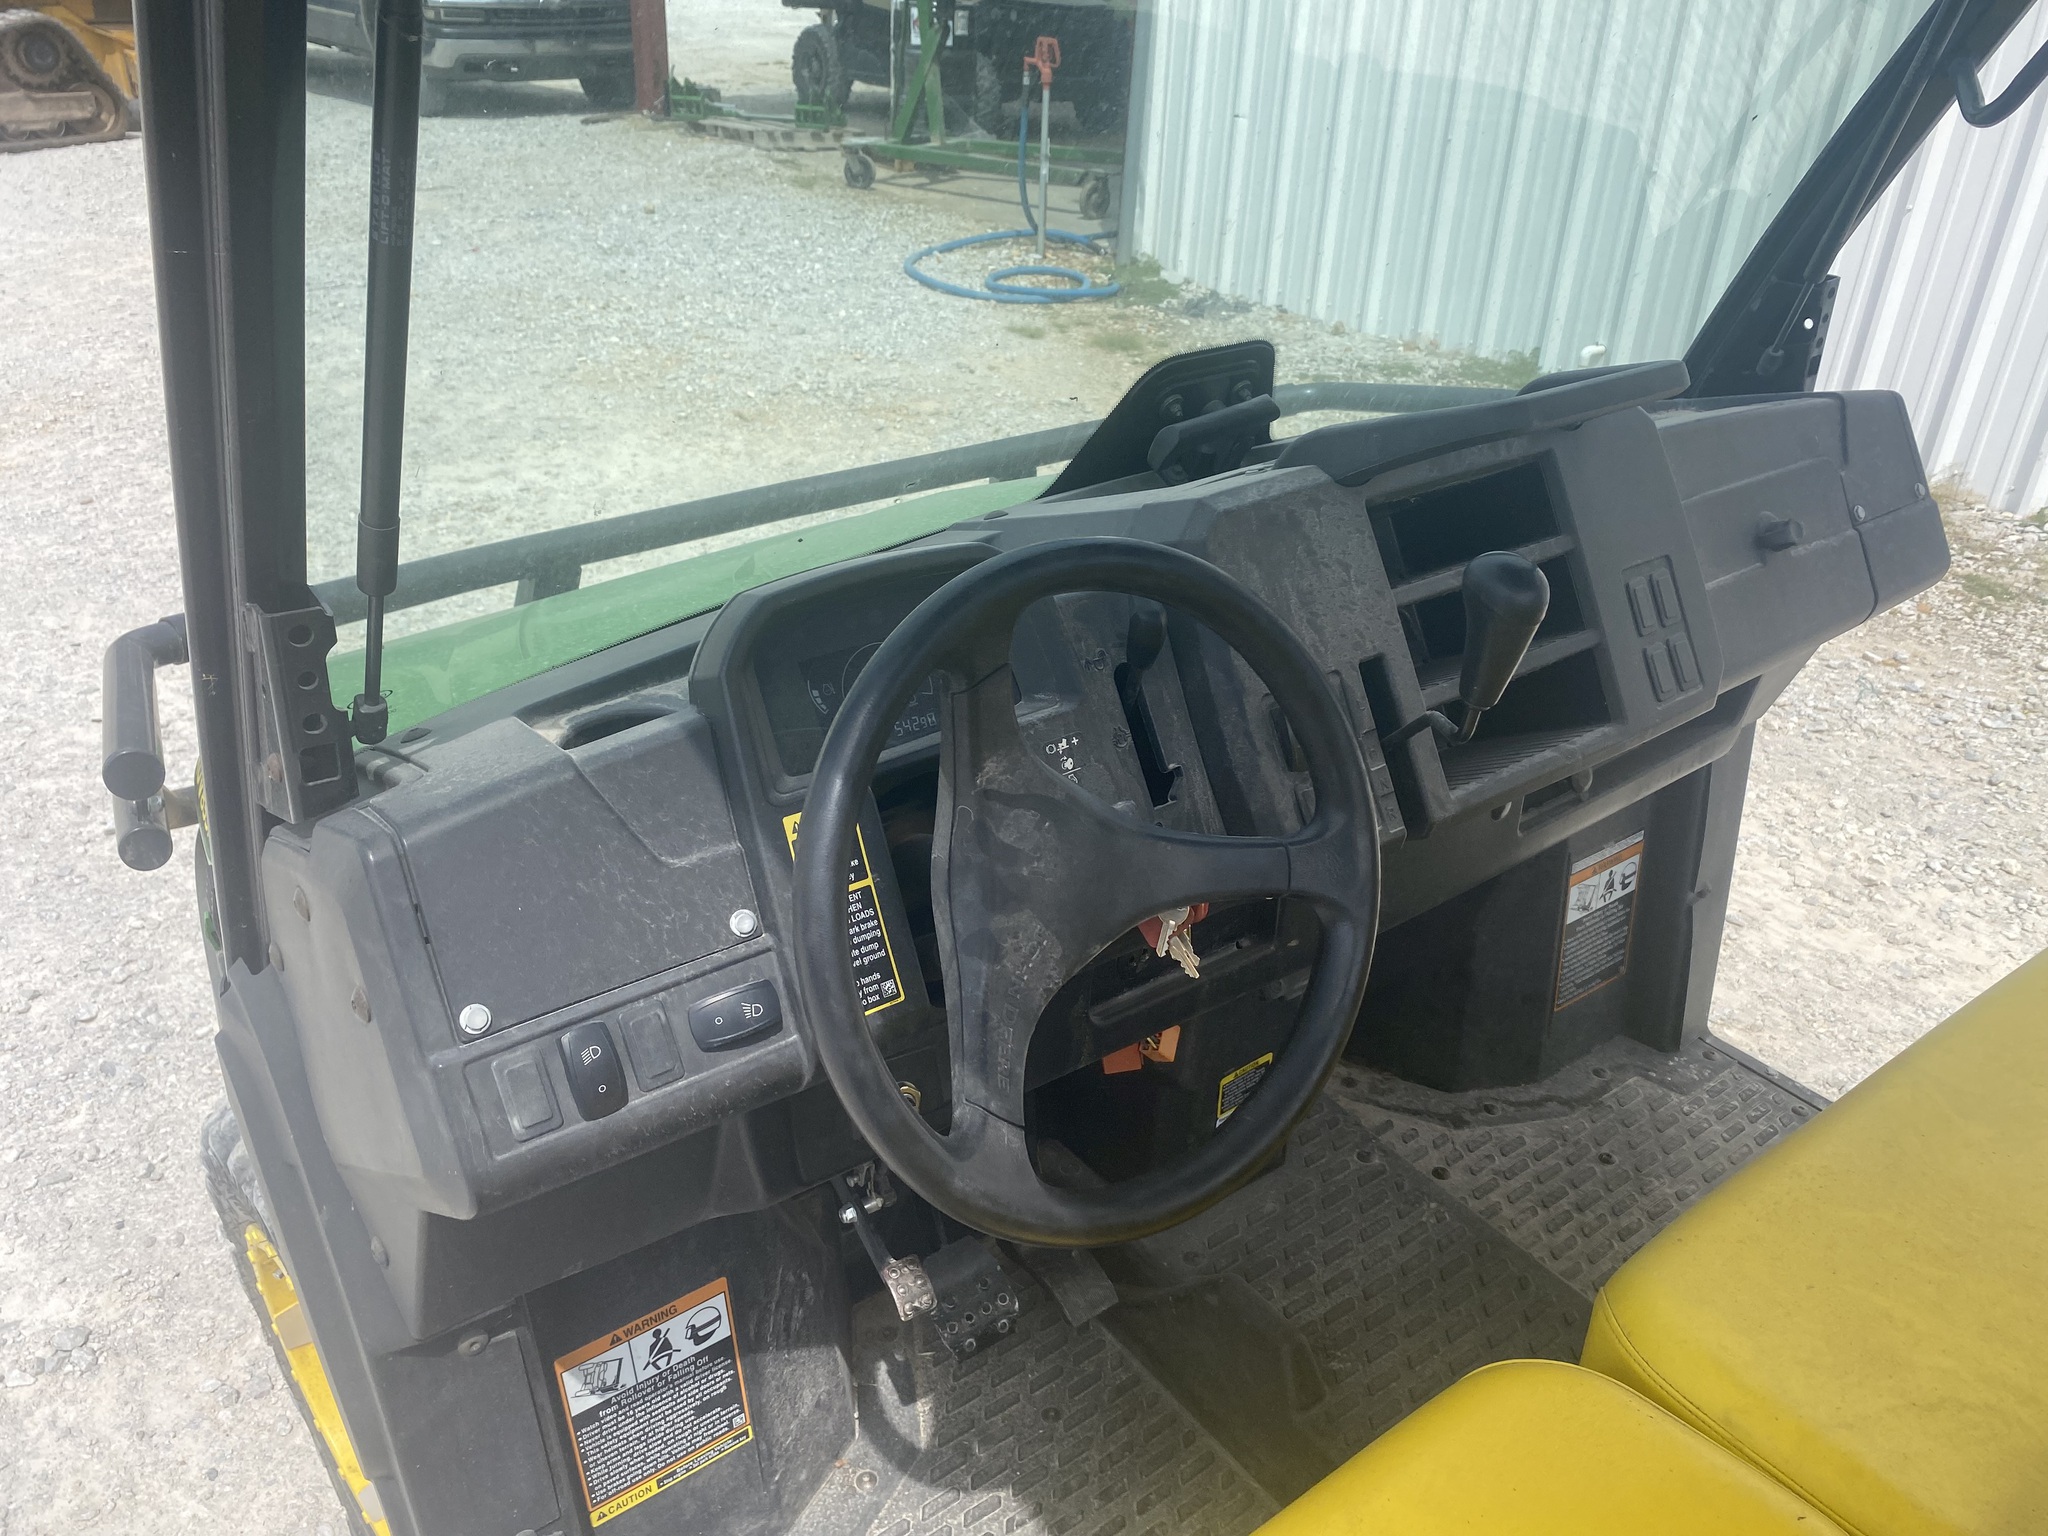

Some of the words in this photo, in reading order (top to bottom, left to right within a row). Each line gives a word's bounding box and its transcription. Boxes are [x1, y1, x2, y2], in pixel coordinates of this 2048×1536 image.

[848, 902, 862, 914] HEN
[849, 925, 860, 935] ark
[861, 919, 878, 931] brake
[851, 908, 874, 922] LOADS
[853, 928, 881, 944] dumping
[861, 942, 879, 954] dump
[863, 949, 886, 965] ground
[861, 972, 881, 984] hands
[864, 983, 879, 995] from
[867, 993, 880, 1004] box
[623, 1303, 677, 1338] WARNING
[581, 1421, 599, 1434] Watch
[600, 1411, 617, 1423] video
[618, 1405, 629, 1414] and
[630, 1398, 643, 1408] read
[644, 1382, 672, 1402] operator's
[674, 1371, 694, 1385] manual
[695, 1361, 712, 1374] before
[582, 1426, 600, 1439] Driver
[601, 1418, 616, 1429] must
[634, 1401, 650, 1413] years
[651, 1395, 660, 1403] old
[661, 1388, 674, 1398] with
[680, 1378, 693, 1388] valid
[694, 1368, 710, 1381] driver
[583, 1433, 600, 1445] Never
[601, 1424, 616, 1436] drive
[617, 1415, 634, 1427] under
[635, 1409, 645, 1418] the
[645, 1395, 671, 1412] influence
[679, 1380, 699, 1395] alcohol
[707, 1367, 725, 1381] drugs.
[599, 1402, 618, 1417] from
[620, 1383, 655, 1406] Rollover
[656, 1378, 665, 1387] or
[667, 1362, 694, 1382] Falling
[696, 1355, 708, 1366] Off
[610, 1386, 634, 1403] Avoid
[636, 1373, 660, 1392] Injury
[661, 1369, 670, 1377] or
[672, 1355, 695, 1371] Death
[585, 1437, 605, 1451] Vehicle
[612, 1419, 638, 1437] equipped
[638, 1413, 650, 1423] with
[651, 1399, 675, 1416] seatbelts
[676, 1393, 686, 1403] and
[687, 1387, 698, 1397] side
[699, 1379, 714, 1390] doors
[722, 1368, 735, 1379] nets.
[586, 1446, 599, 1456] This
[600, 1436, 618, 1450] safety
[619, 1420, 648, 1440] equipment
[649, 1412, 663, 1423] must
[672, 1400, 686, 1411] used
[703, 1376, 732, 1396] occupants.
[587, 1451, 602, 1462] Wear
[603, 1438, 627, 1454] helmets
[627, 1429, 643, 1441] when
[644, 1418, 664, 1433] driving
[710, 1384, 727, 1398] rough
[597, 1450, 617, 1464] uneven
[654, 1420, 672, 1434] higher
[673, 1408, 695, 1423] speeds.
[590, 1462, 605, 1474] Keep
[606, 1455, 620, 1465] arms
[621, 1447, 632, 1457] and
[633, 1440, 646, 1451] legs
[647, 1431, 664, 1443] inside
[665, 1420, 683, 1434] during
[591, 1467, 608, 1479] While
[632, 1446, 647, 1457] drive
[648, 1438, 661, 1449] slow
[662, 1432, 673, 1441] and
[682, 1422, 692, 1430] not
[693, 1405, 722, 1425] accelerate.
[593, 1473, 608, 1485] Drive
[609, 1463, 628, 1477] slowly
[629, 1454, 644, 1465] when
[675, 1428, 691, 1441] rough
[699, 1414, 719, 1427] uneven
[595, 1487, 606, 1496] Use
[607, 1476, 625, 1489] brakes
[626, 1467, 641, 1480] going
[642, 1459, 656, 1470] down
[657, 1452, 670, 1462] hills.
[671, 1441, 690, 1455] Vehicle
[691, 1435, 702, 1444] may
[703, 1419, 729, 1437] freewheel.
[597, 1492, 606, 1501] For
[607, 1480, 630, 1495] off-road
[631, 1474, 641, 1482] use
[643, 1465, 656, 1477] only.
[666, 1455, 675, 1464] not
[676, 1450, 686, 1458] use
[695, 1435, 712, 1448] public
[713, 1425, 729, 1438] roads.
[602, 1474, 619, 1487] paved
[645, 1451, 660, 1462] while
[661, 1437, 686, 1455] operating
[693, 1426, 707, 1437] night
[720, 1408, 741, 1422] reverse.
[607, 1484, 652, 1515] CAUTION
